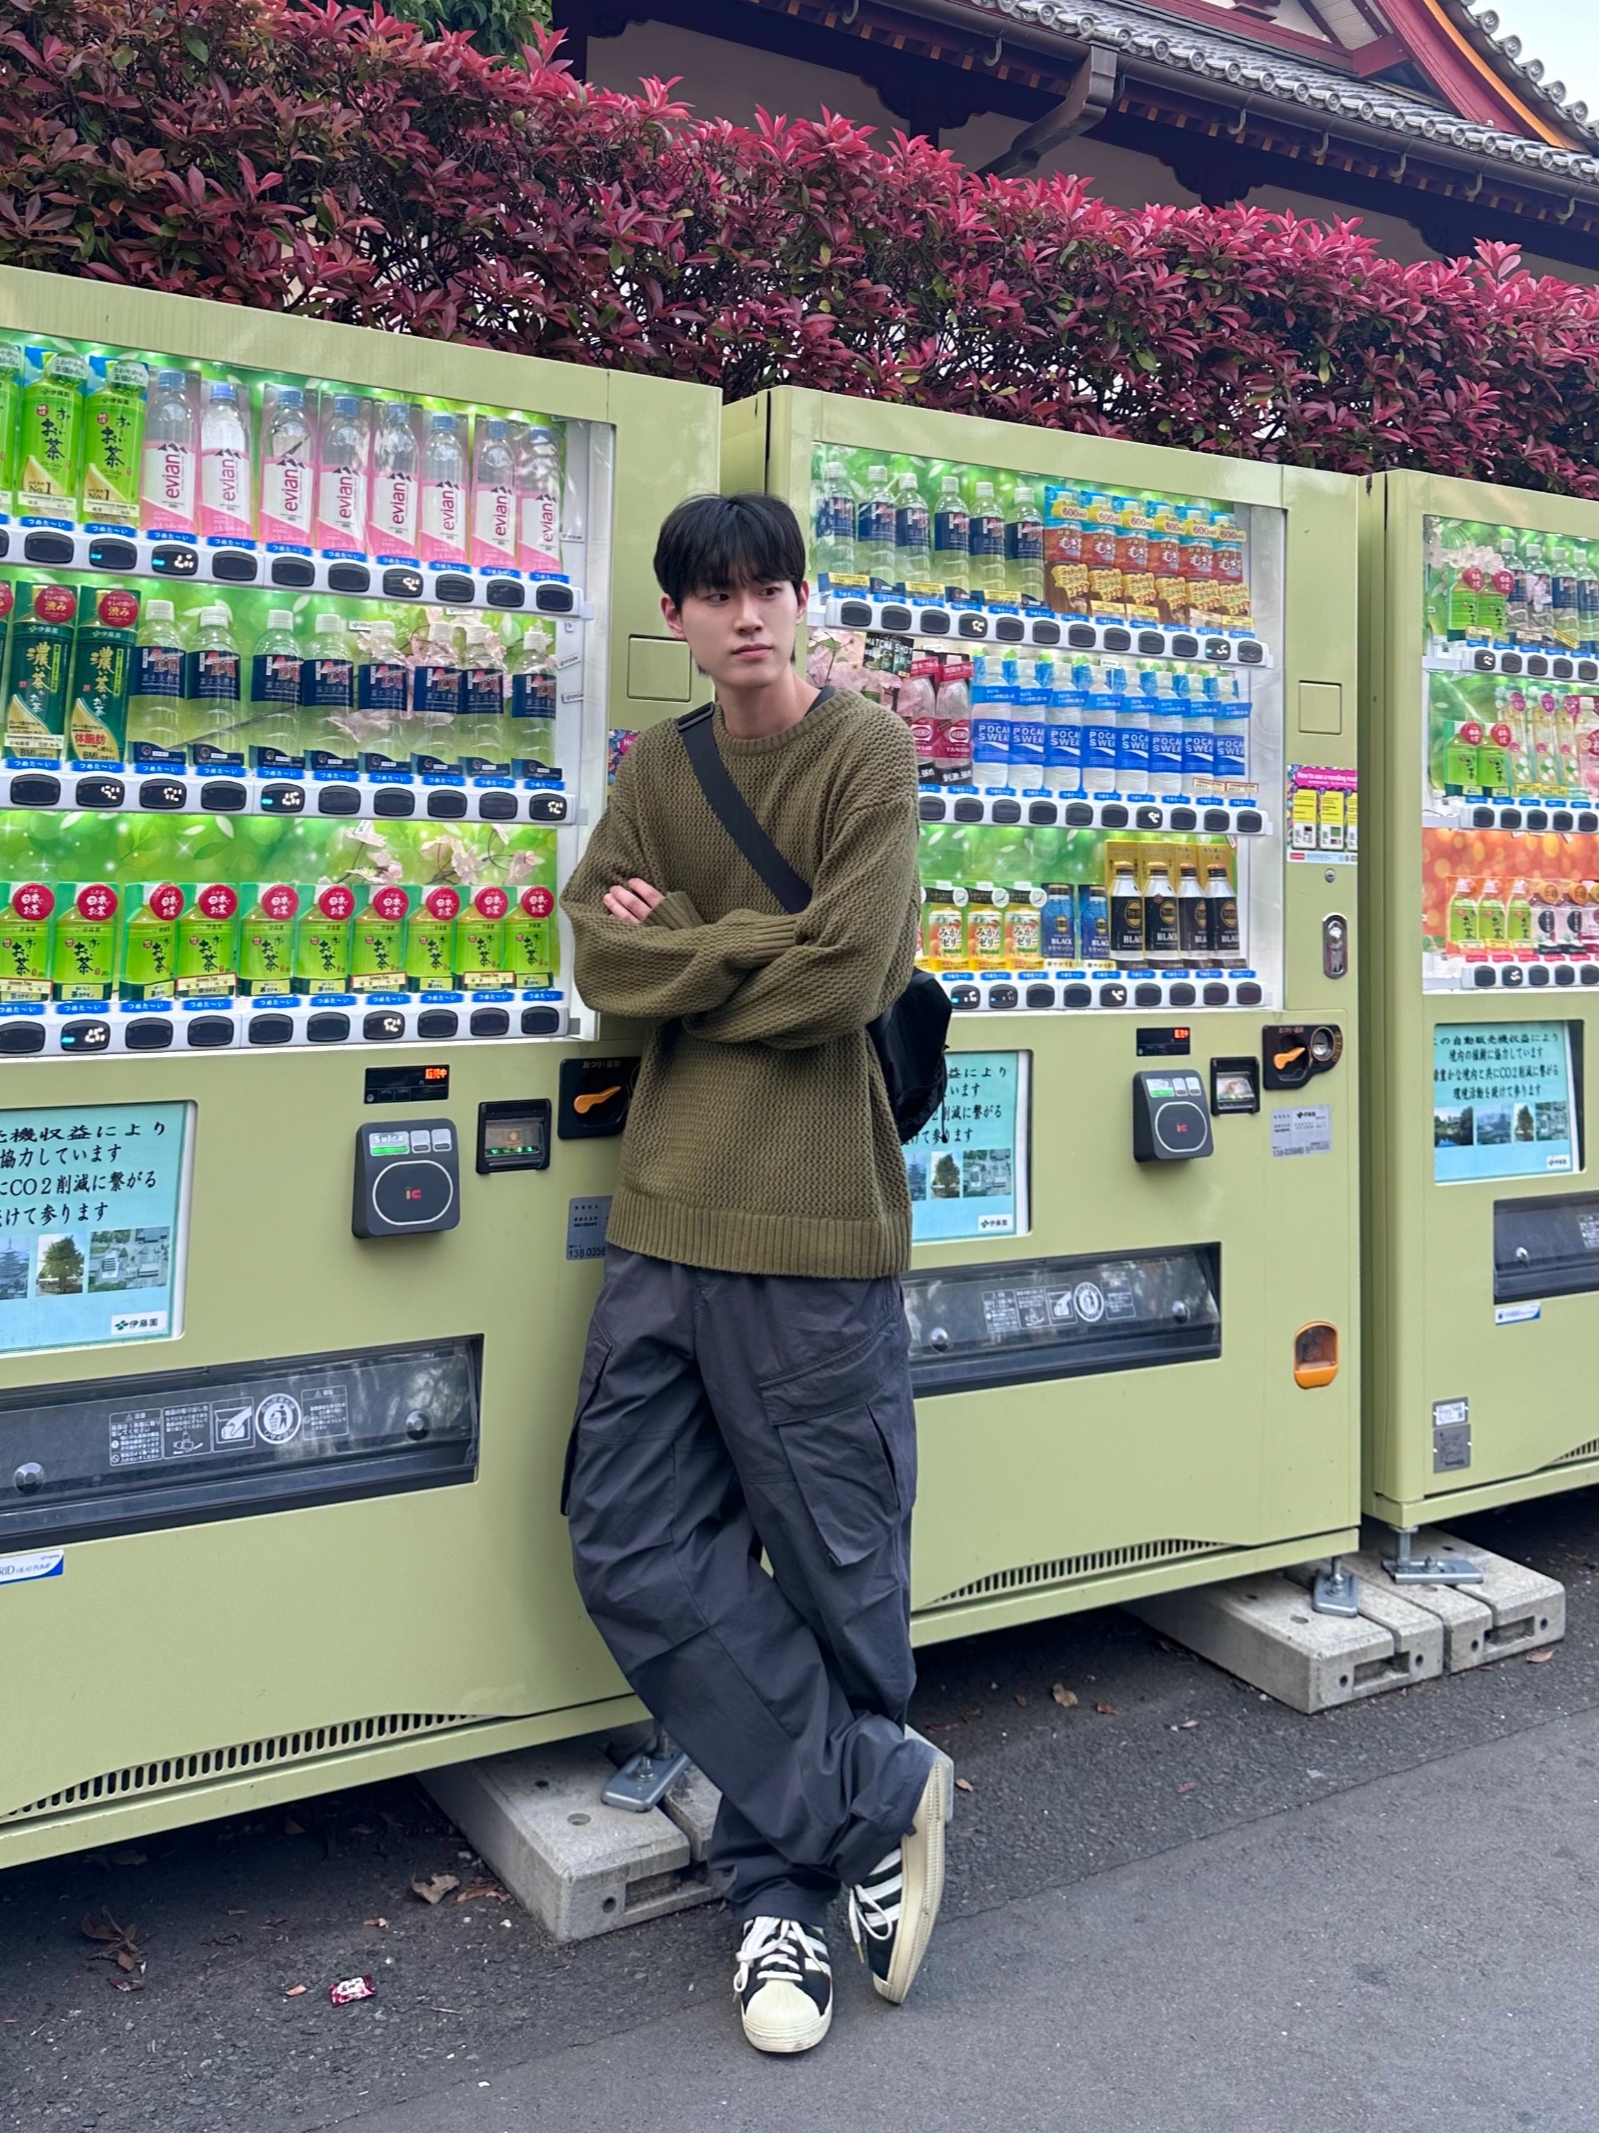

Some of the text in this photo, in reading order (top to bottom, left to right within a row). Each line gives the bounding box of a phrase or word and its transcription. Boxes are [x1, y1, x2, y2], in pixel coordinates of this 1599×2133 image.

[41, 418, 65, 460] お茶
[101, 426, 124, 468] お茶
[162, 454, 181, 498] evian
[220, 458, 236, 502] evian
[281, 469, 299, 512] evian
[336, 476, 353, 518] evian
[390, 482, 406, 524] evian
[440, 490, 454, 531] evian
[1062, 508, 1086, 518] 600ml
[493, 496, 508, 536] evian
[540, 503, 554, 542] evian
[1131, 518, 1153, 527] 600ml
[1193, 526, 1217, 536] 600ml
[1220, 531, 1244, 540] 600ml
[75, 734, 106, 746] 体脂肪
[0, 1122, 165, 1143] 機収益により
[374, 1135, 404, 1143] Suica
[0, 1202, 108, 1227] けて参ります
[129, 1318, 158, 1328] 伊藤園
[16, 1566, 32, 1574] HEAT
[33, 1562, 52, 1571] PUMP
